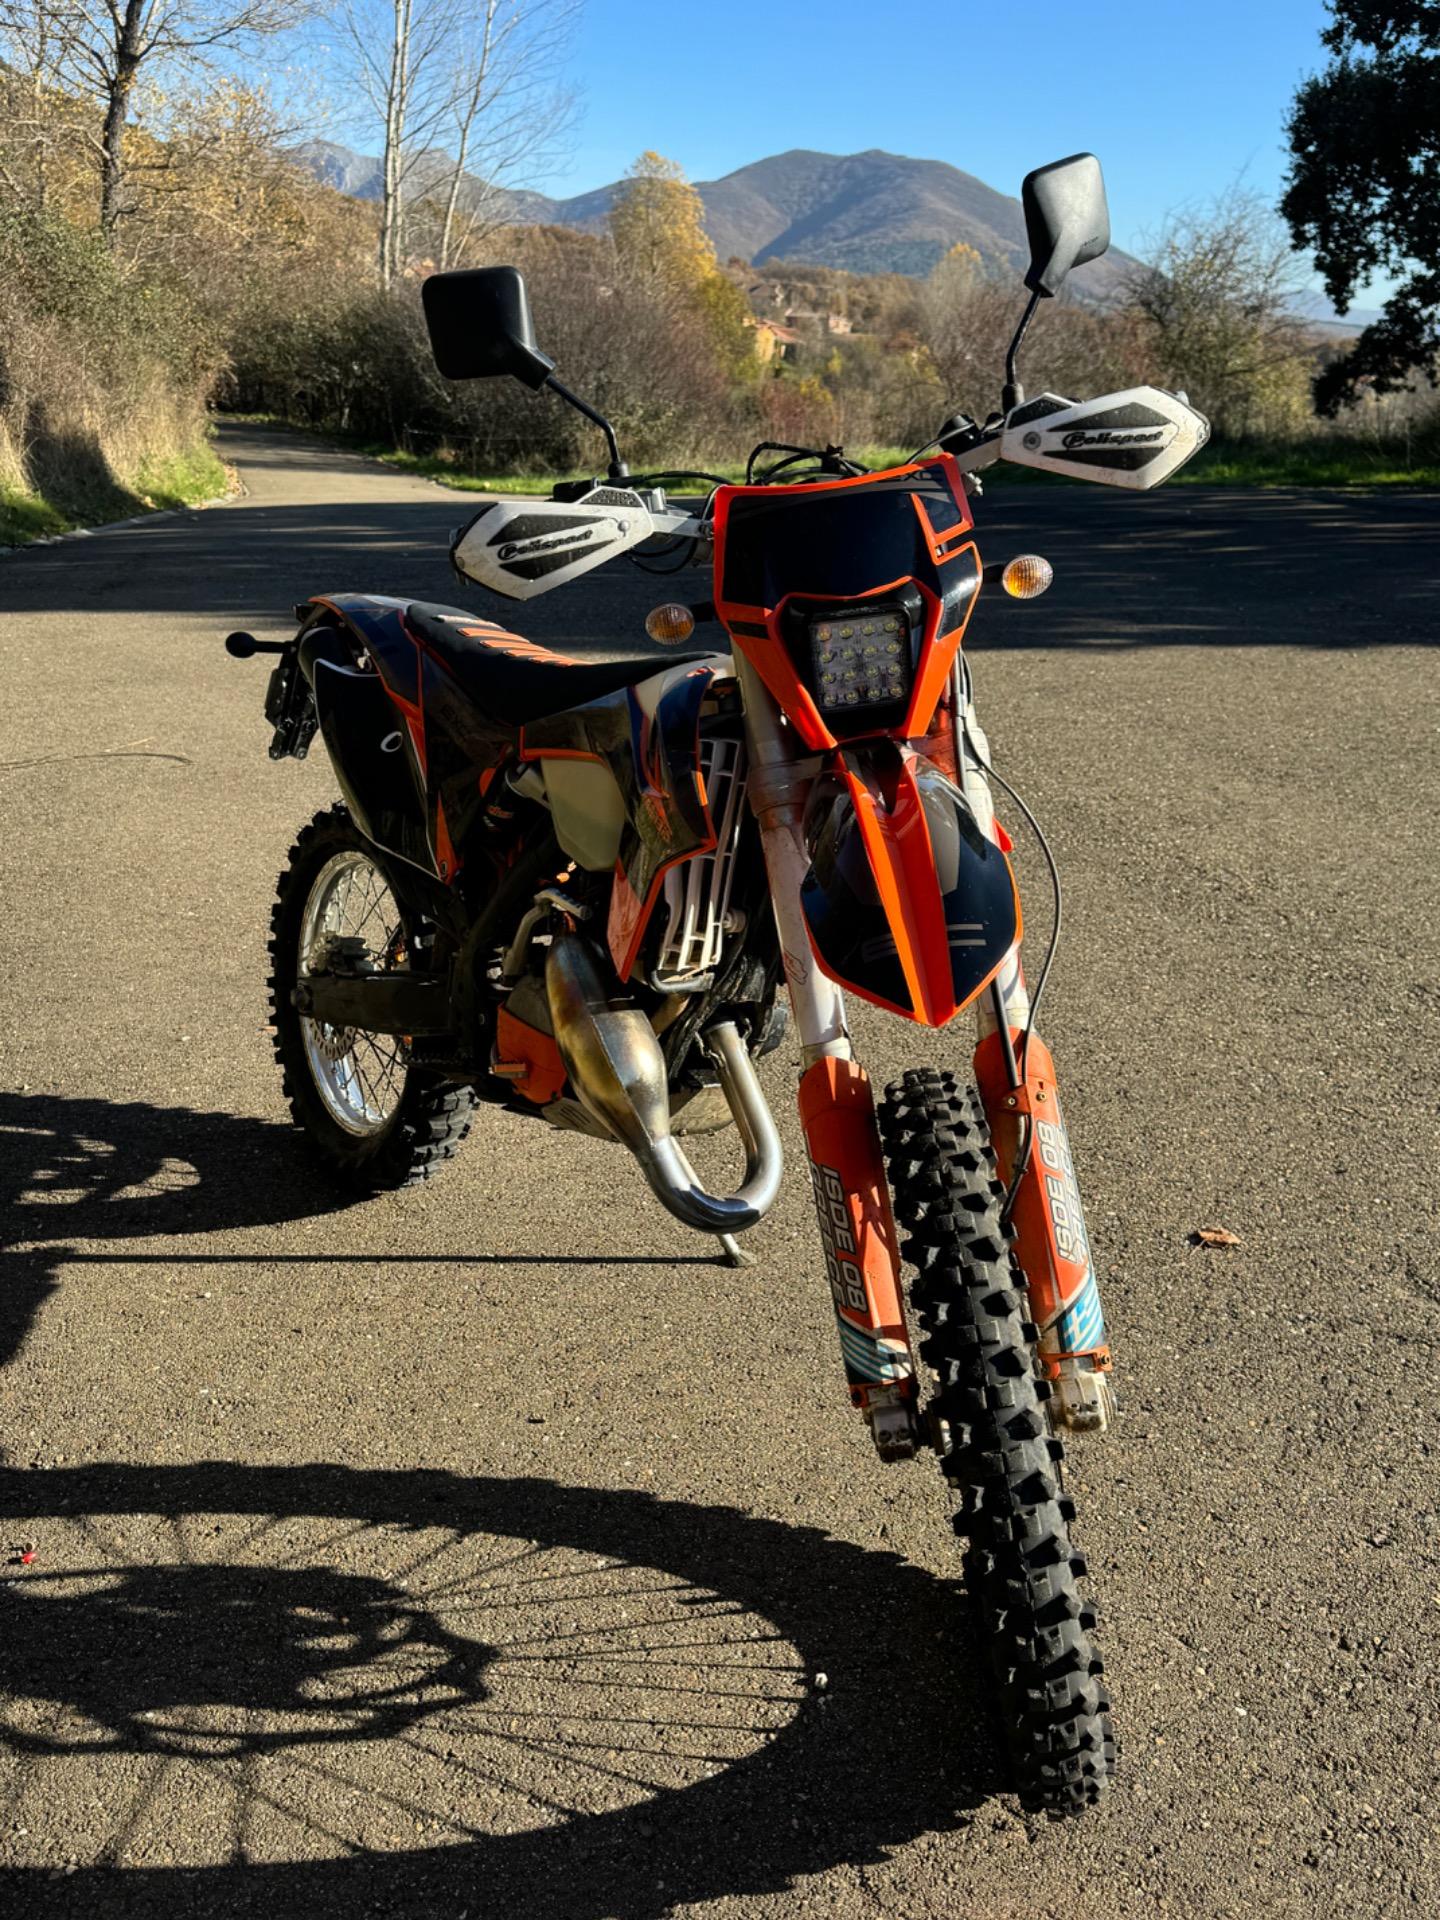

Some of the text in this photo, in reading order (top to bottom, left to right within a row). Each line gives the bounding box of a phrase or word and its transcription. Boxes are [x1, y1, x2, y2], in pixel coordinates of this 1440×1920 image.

[1062, 431, 1164, 448] Polisport
[822, 1164, 868, 1314] ISDE 08
[1036, 1119, 1078, 1265] ISDE 08
